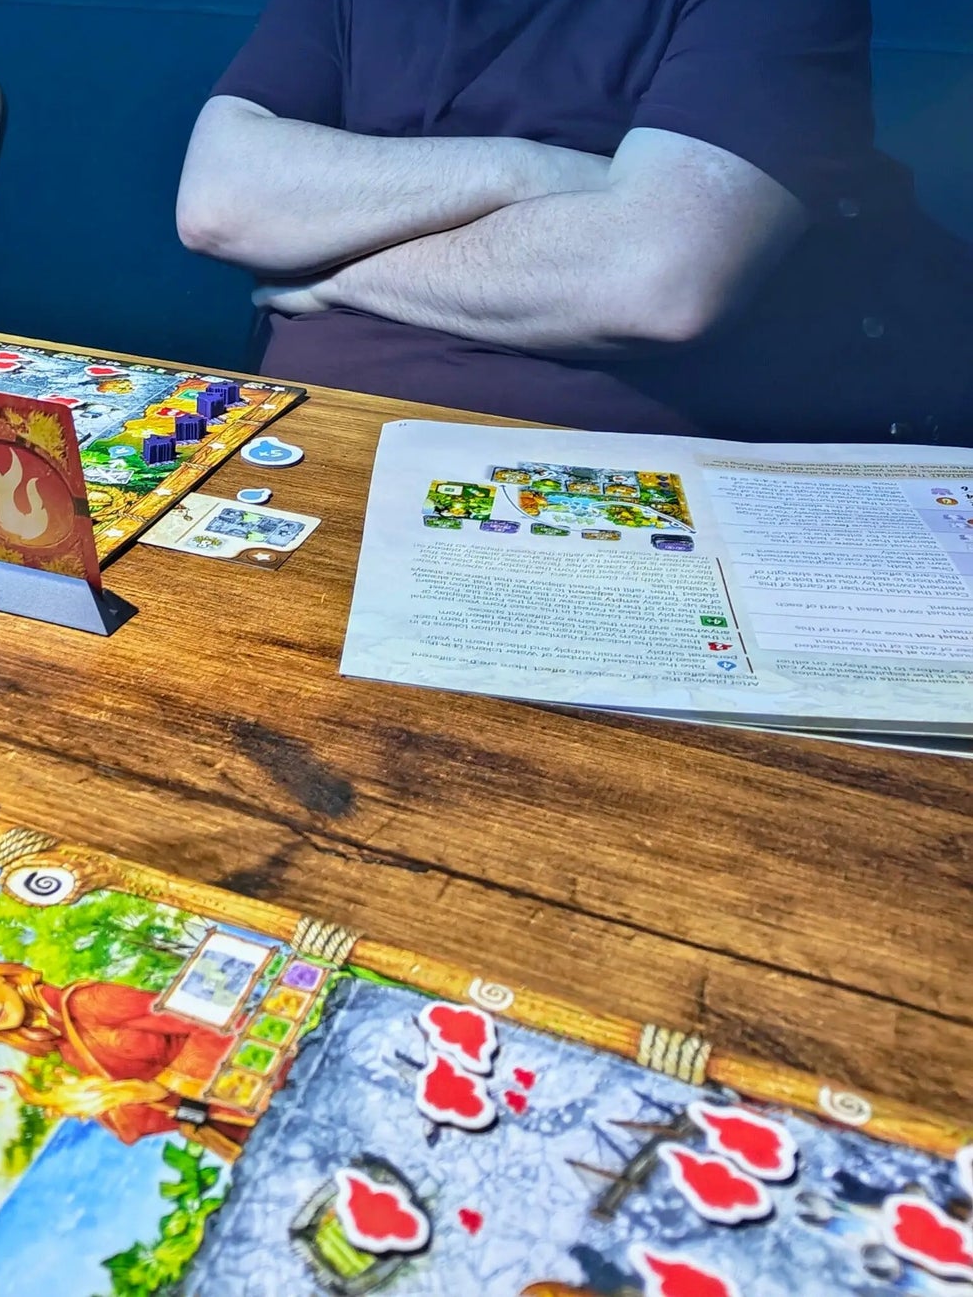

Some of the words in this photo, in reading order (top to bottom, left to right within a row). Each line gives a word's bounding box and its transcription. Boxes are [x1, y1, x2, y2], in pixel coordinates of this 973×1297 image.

[507, 611, 550, 619] different
[470, 618, 500, 626] place
[471, 624, 517, 634] Pollution
[577, 624, 626, 633] Pollution
[535, 631, 577, 639] number
[464, 638, 493, 646] them
[580, 636, 630, 644] indicated
[466, 644, 501, 652] tokens
[496, 641, 526, 649] place
[655, 642, 702, 650] Remove
[553, 646, 591, 655] supply
[411, 652, 456, 662] different
[555, 653, 599, 661] number
[687, 651, 738, 661] personal
[603, 657, 656, 666] indicated
[791, 670, 849, 678] examples
[682, 675, 727, 685] playing
[728, 679, 760, 687] After
